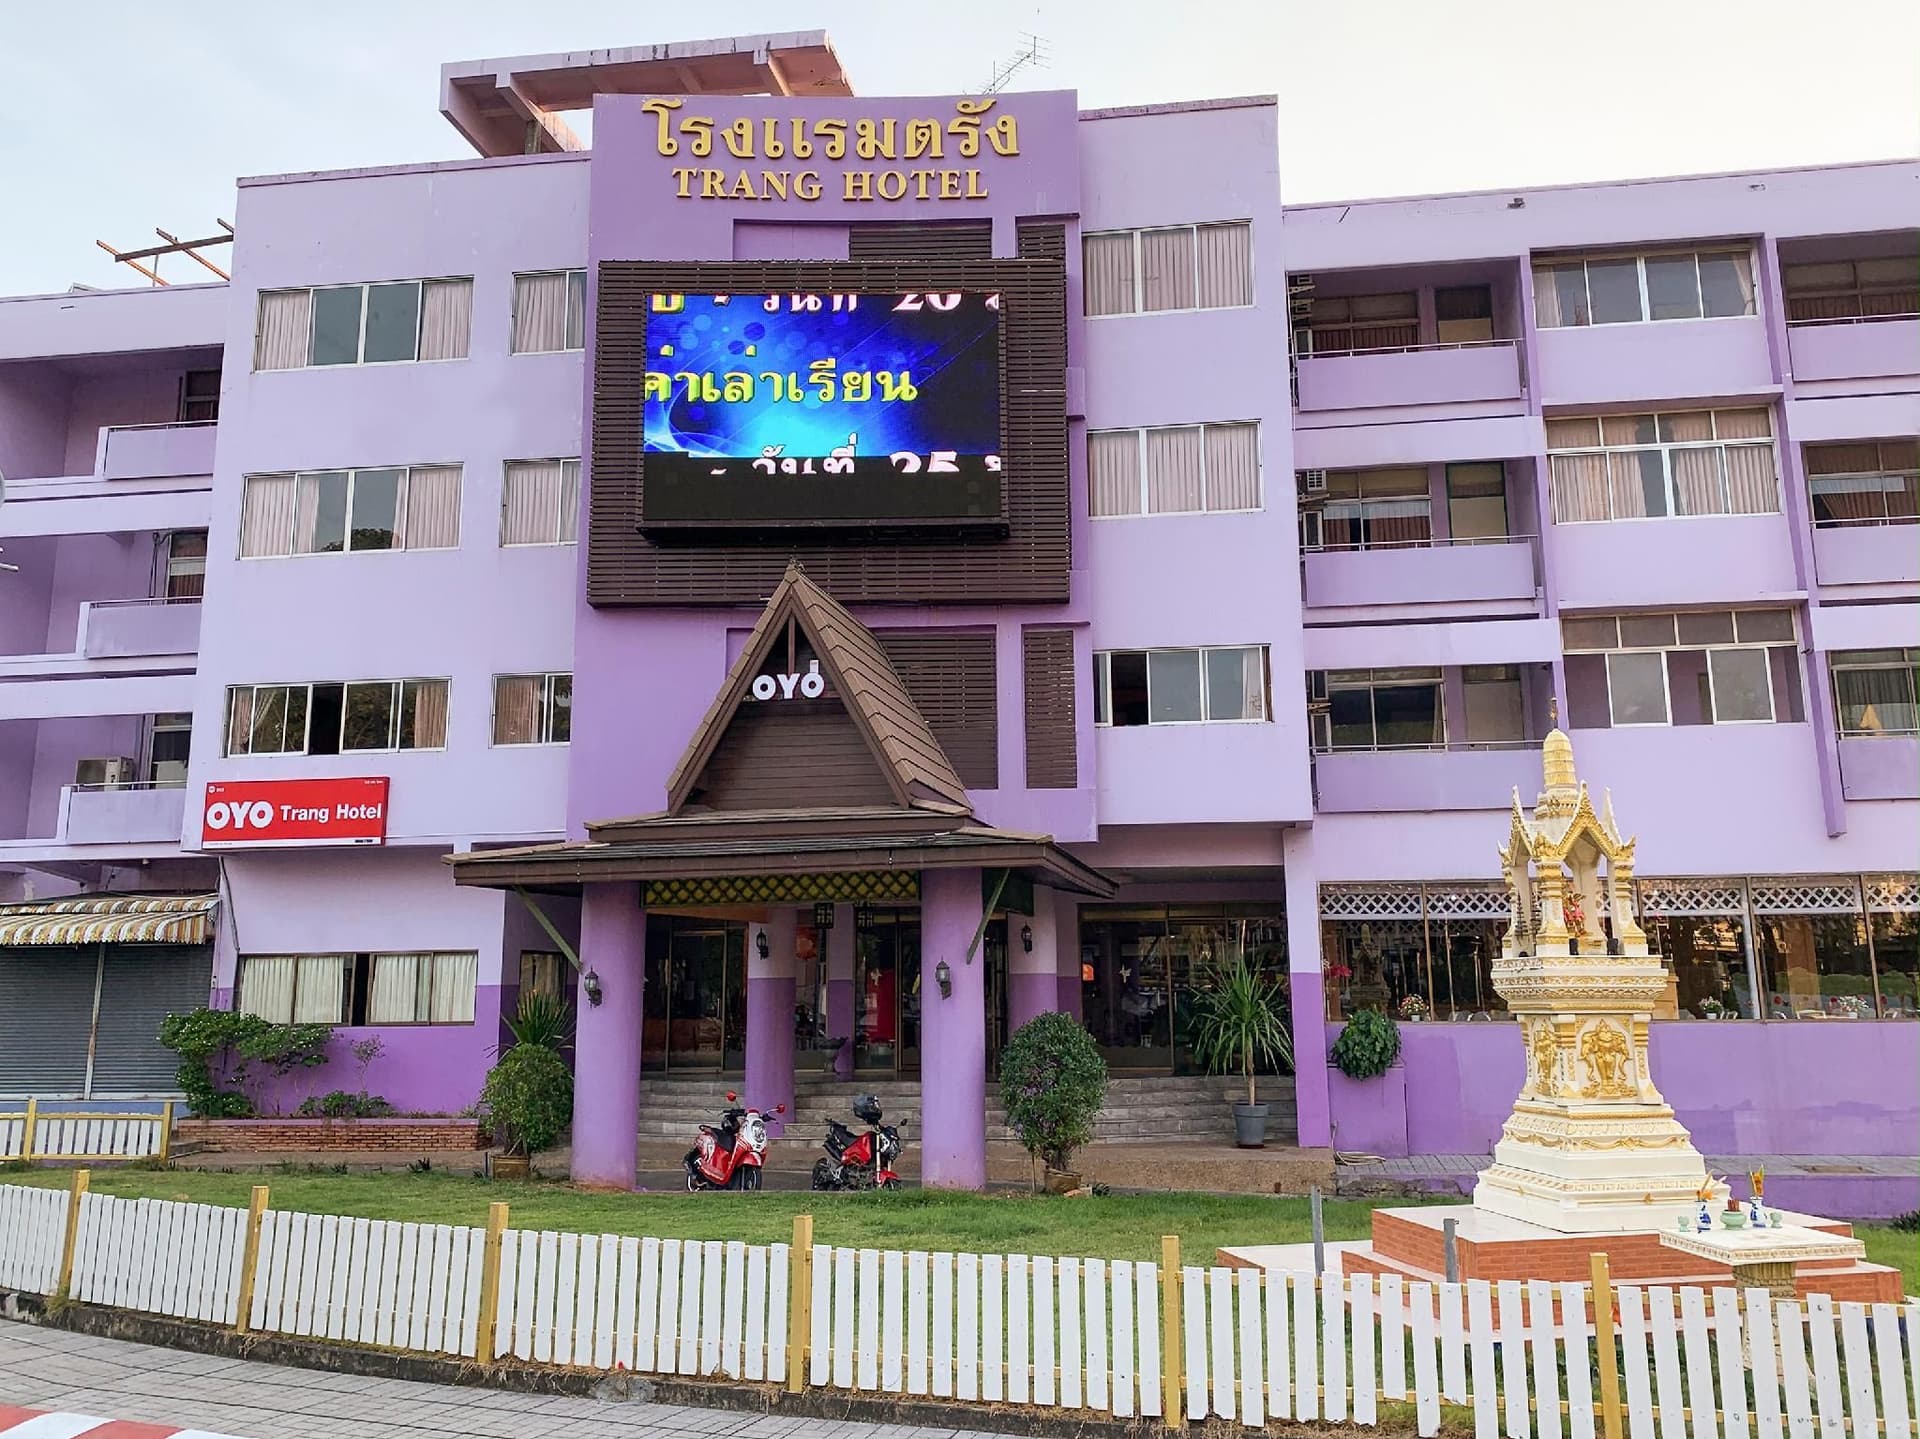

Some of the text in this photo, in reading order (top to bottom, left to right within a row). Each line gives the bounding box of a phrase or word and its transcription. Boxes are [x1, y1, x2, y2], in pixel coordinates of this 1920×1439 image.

[641, 98, 1021, 159] โรงแรมตรัง
[672, 168, 989, 200] TRANG HOTEL
[644, 345, 918, 402] ค่าเล่าเรียน
[752, 671, 825, 700] OYO
[206, 801, 382, 829] OYO Trang Hotel
